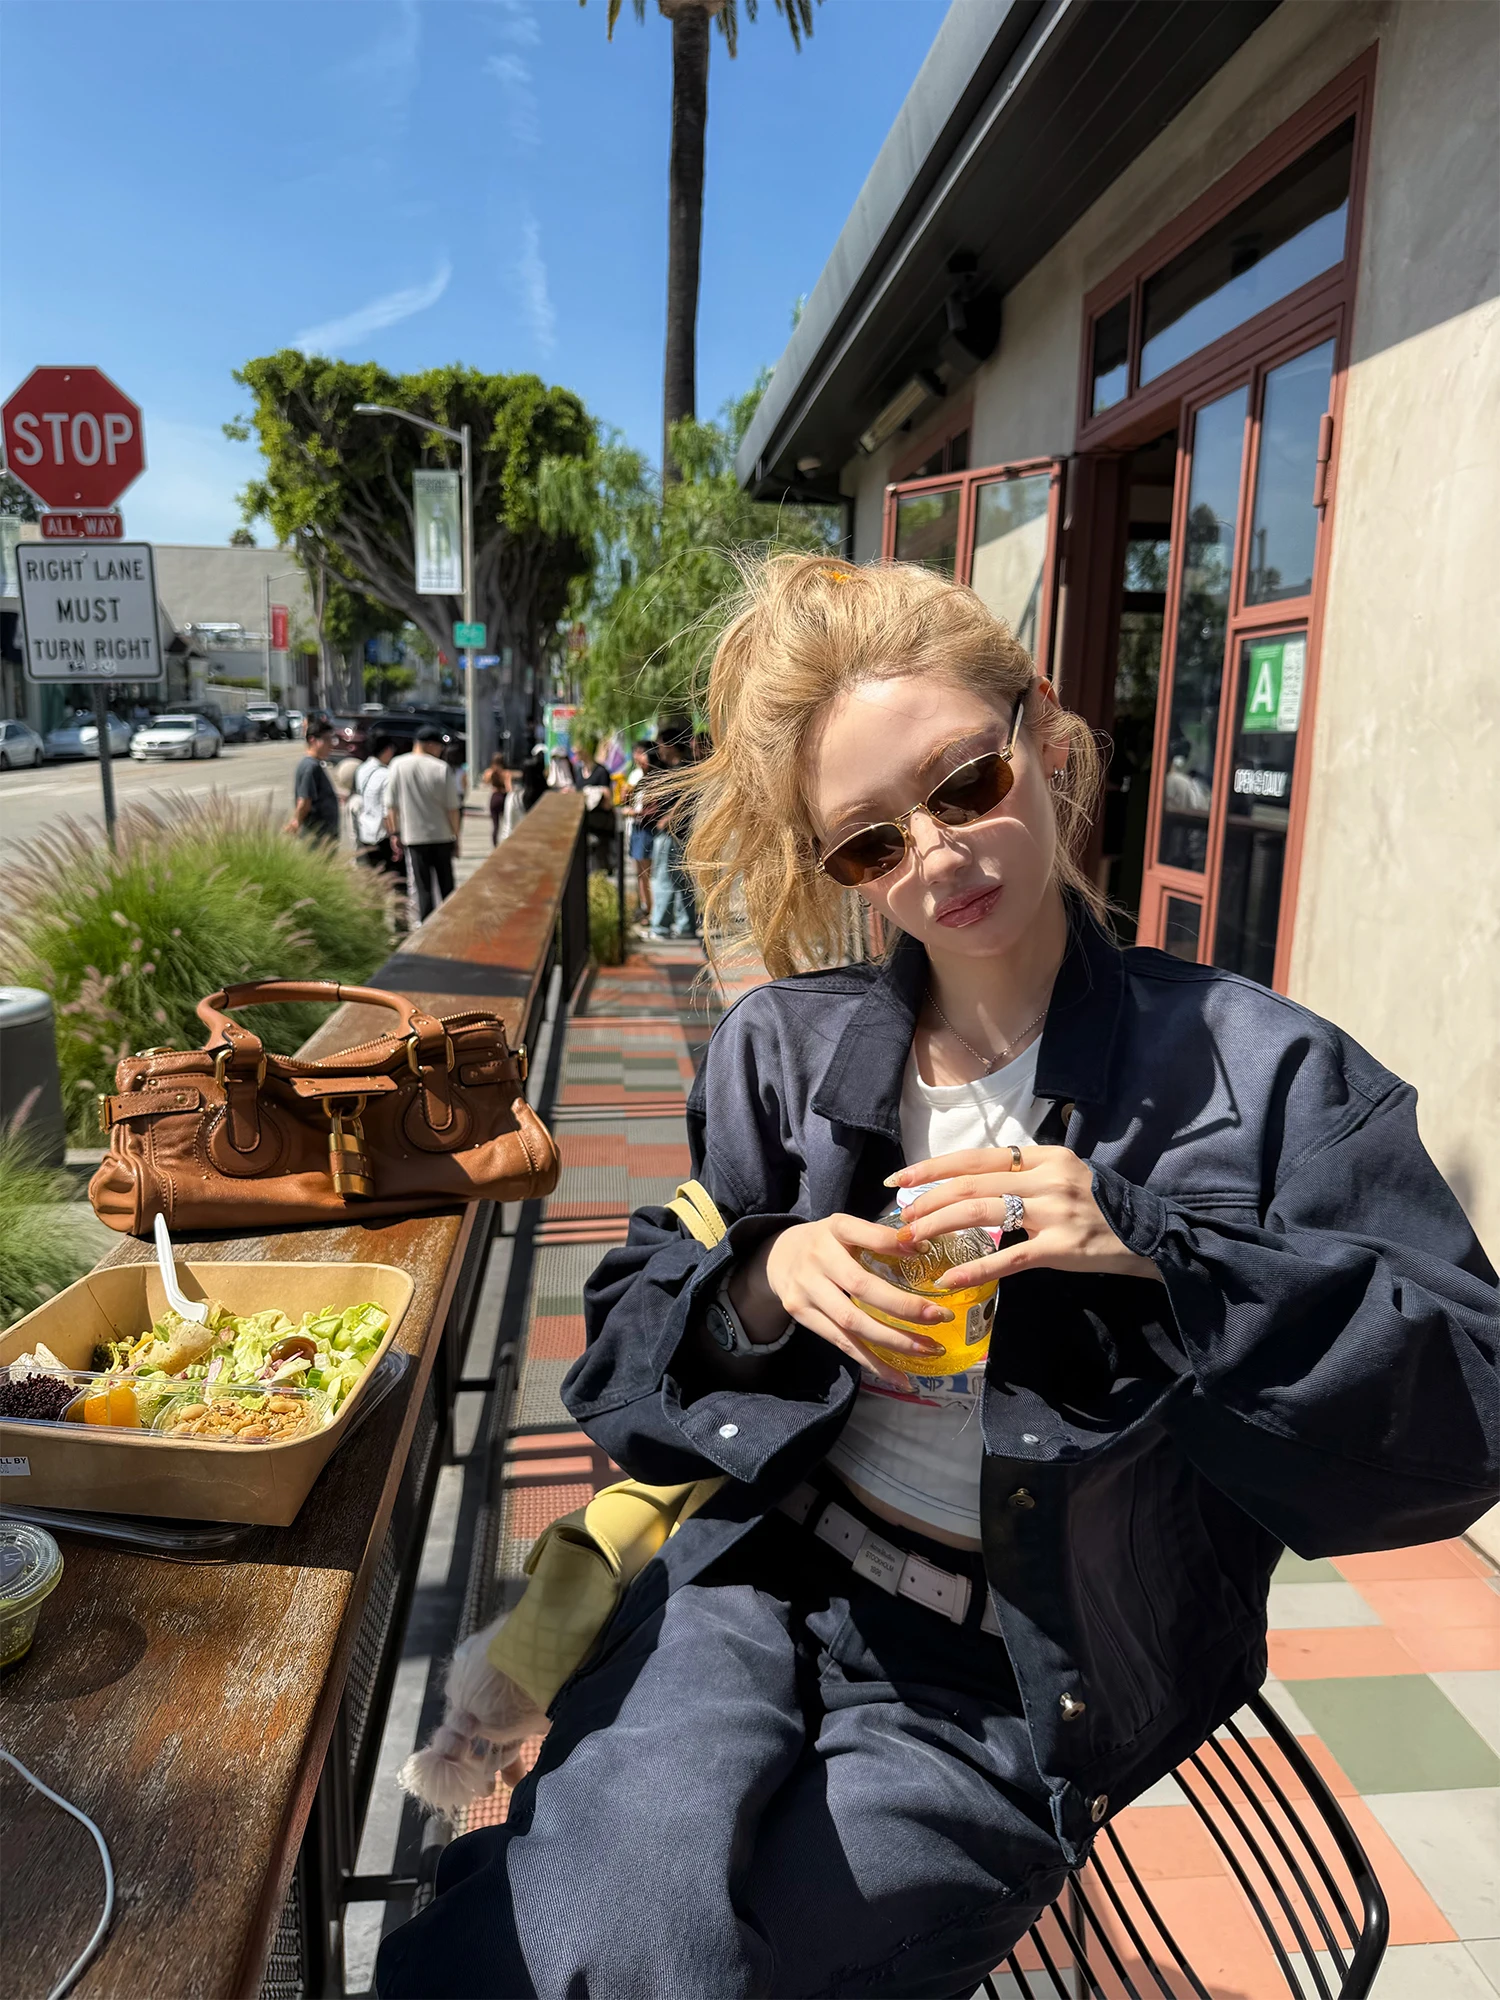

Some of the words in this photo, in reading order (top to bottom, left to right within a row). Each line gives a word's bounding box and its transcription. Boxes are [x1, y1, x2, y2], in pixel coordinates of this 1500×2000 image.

[13, 411, 133, 466] STOP
[46, 516, 76, 536] ALL
[83, 515, 118, 535] WAY
[26, 559, 84, 581] RIGHT
[94, 558, 145, 581] LANE
[56, 597, 121, 623] MUST
[32, 639, 86, 660] TURN
[95, 638, 152, 660] RIGHT
[1250, 661, 1275, 713] A
[866, 1550, 894, 1572] STOCKHOLM
